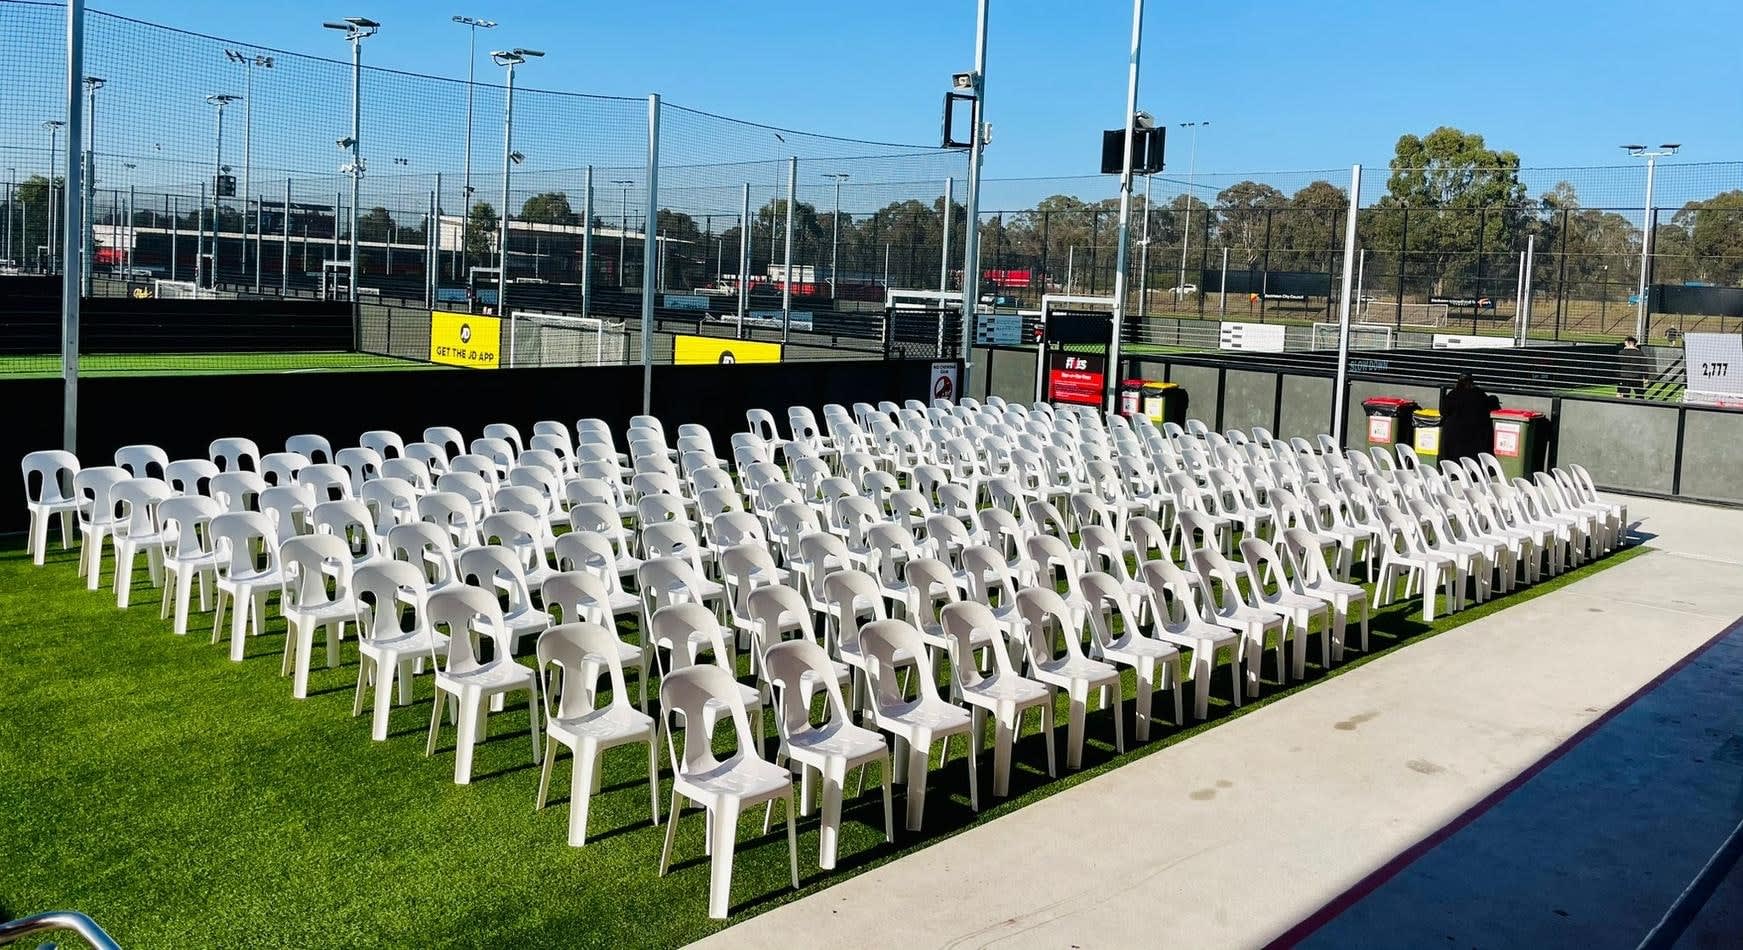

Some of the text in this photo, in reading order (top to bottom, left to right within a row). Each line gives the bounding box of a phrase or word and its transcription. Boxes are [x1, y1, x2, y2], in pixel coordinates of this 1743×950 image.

[436, 346, 494, 362] GET THE JD APP
[1702, 362, 1728, 379] 2,777
